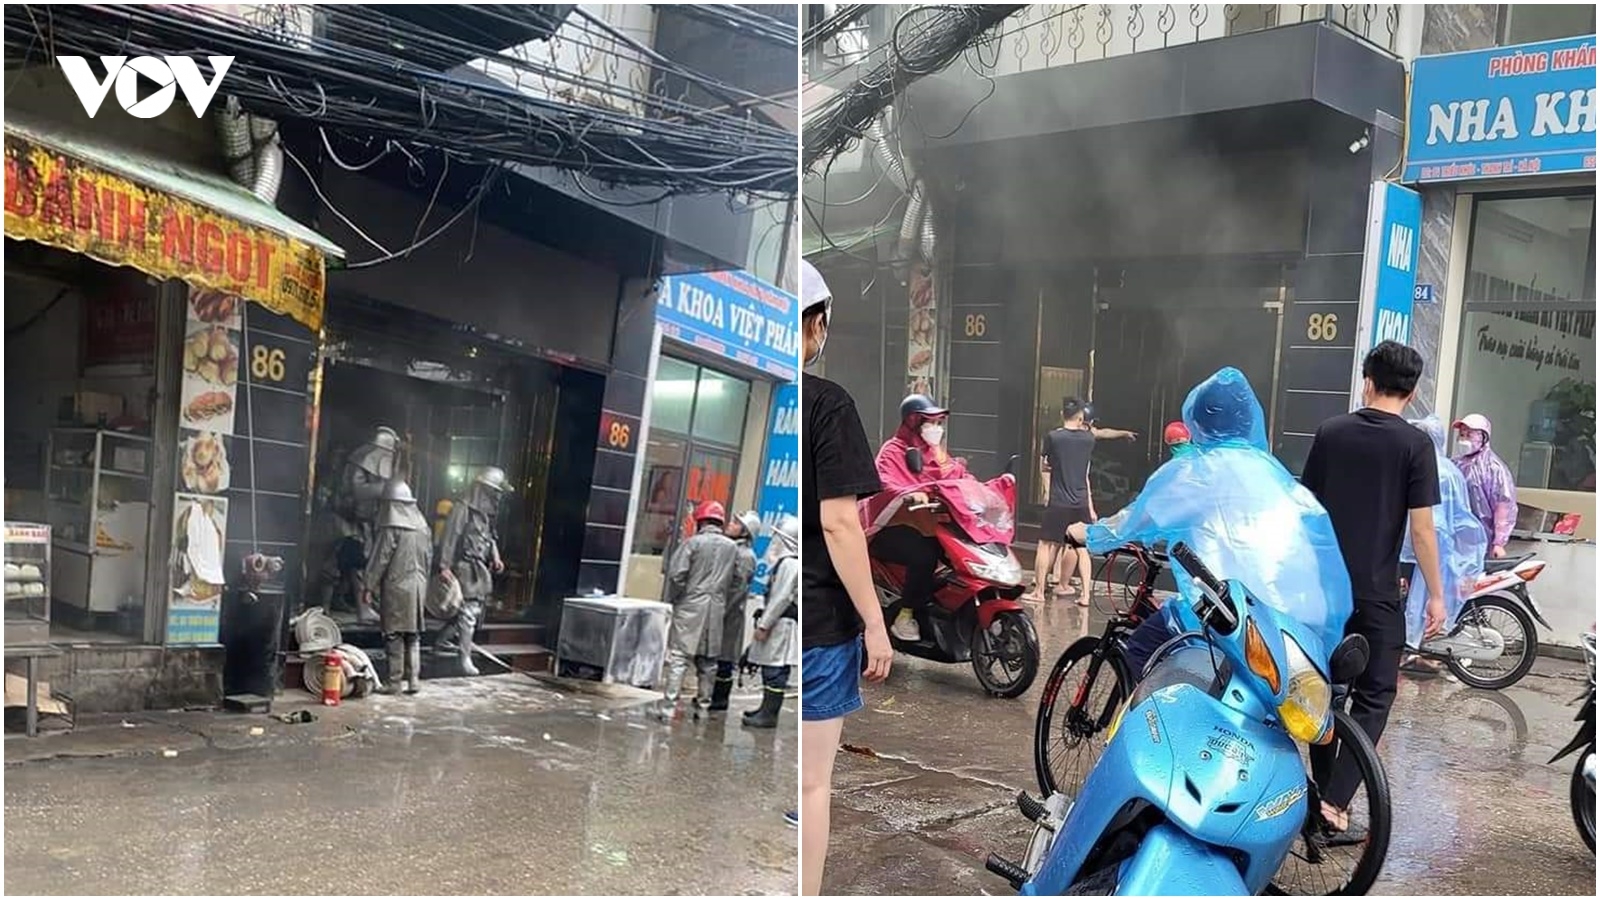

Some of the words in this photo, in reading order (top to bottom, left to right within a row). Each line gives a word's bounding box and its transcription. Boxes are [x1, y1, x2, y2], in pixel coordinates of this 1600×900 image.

[1489, 50, 1548, 78] PHÒNG
[1426, 97, 1519, 145] NHA
[1387, 222, 1413, 272] NHA
[1414, 286, 1428, 299] 84
[677, 281, 724, 329] KHOA
[730, 302, 764, 346] VIỆT
[965, 314, 985, 336] 86
[1308, 313, 1338, 341] 86
[1375, 308, 1409, 347] KHOA
[252, 345, 286, 381] 86
[609, 421, 630, 449] 86
[1213, 725, 1256, 752] HONDA
